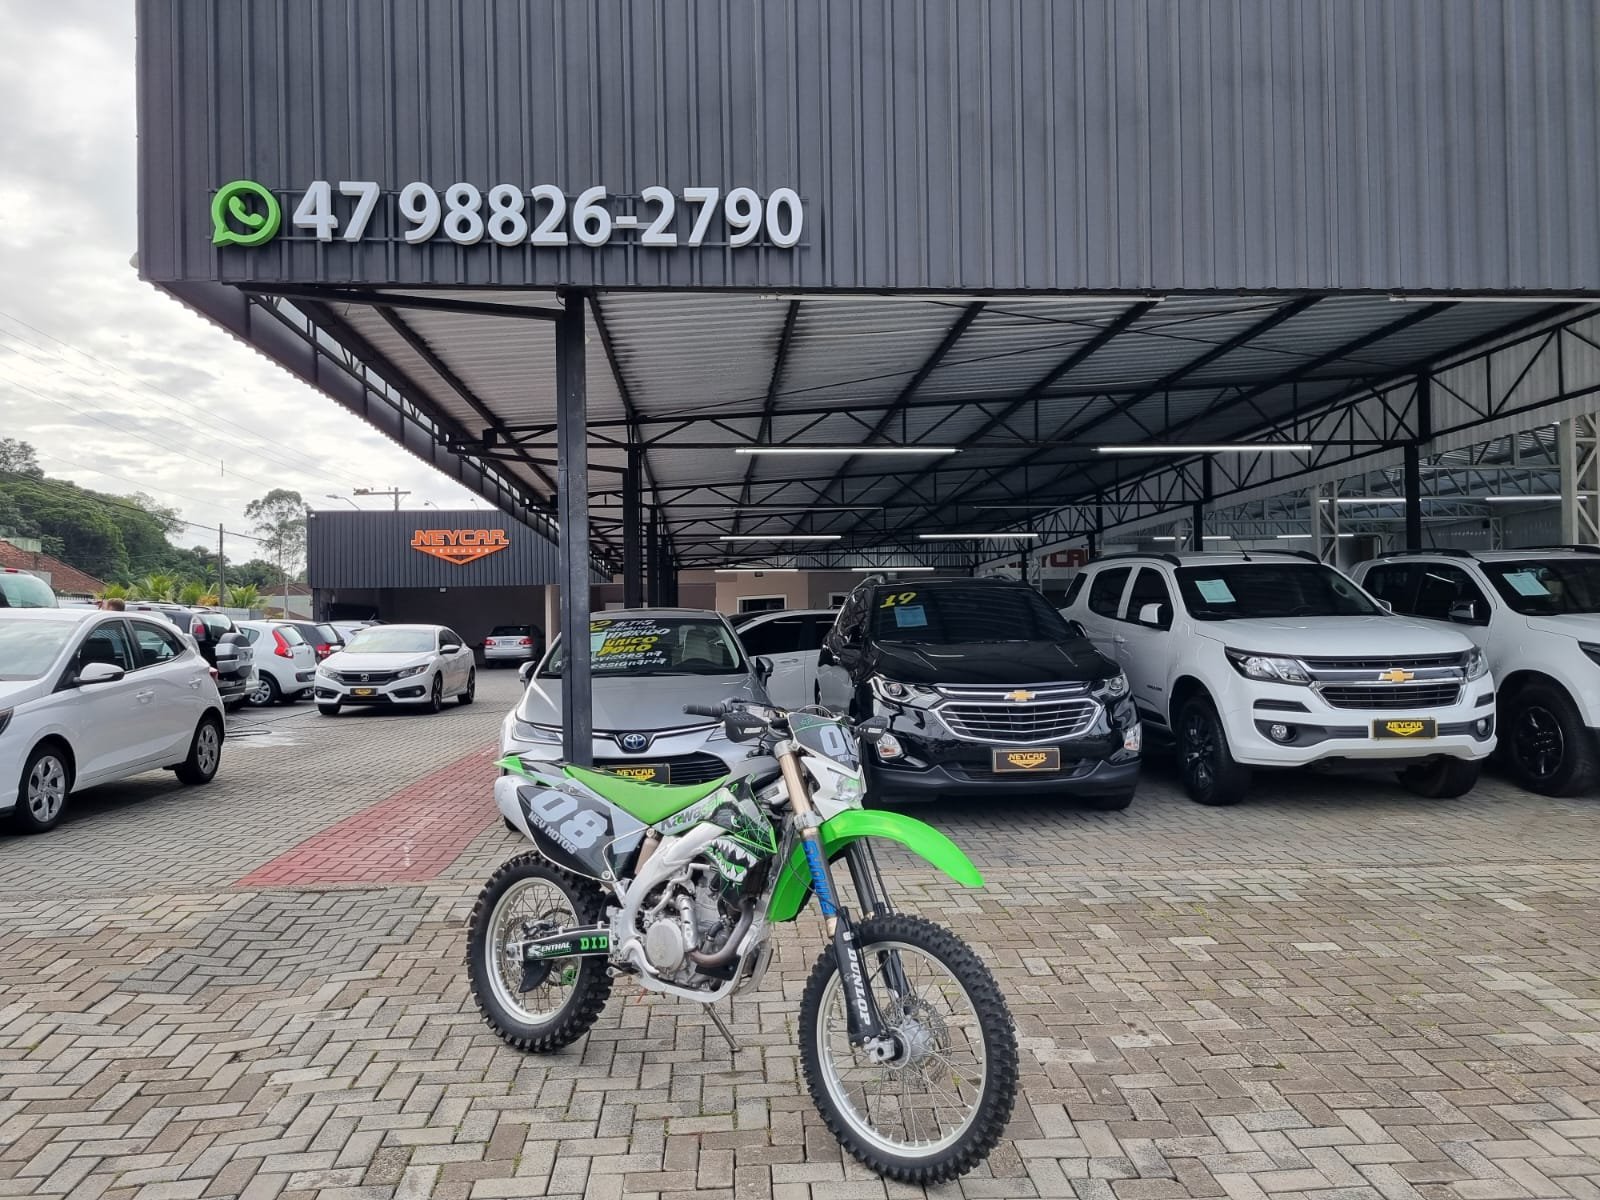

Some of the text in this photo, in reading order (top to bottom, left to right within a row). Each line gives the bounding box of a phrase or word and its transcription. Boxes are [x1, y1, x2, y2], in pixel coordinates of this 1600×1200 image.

[293, 181, 803, 248] 47 98826-2790
[411, 529, 510, 546] NEYCAR
[880, 592, 917, 608] 19
[1386, 721, 1424, 729] NEYCAR
[1007, 752, 1047, 761] NEYCAR
[616, 768, 656, 777] NEYCAR
[531, 789, 608, 849] 08
[544, 825, 578, 855] MOTOS
[580, 936, 608, 950] DID
[847, 948, 871, 1026] DUNLOP
